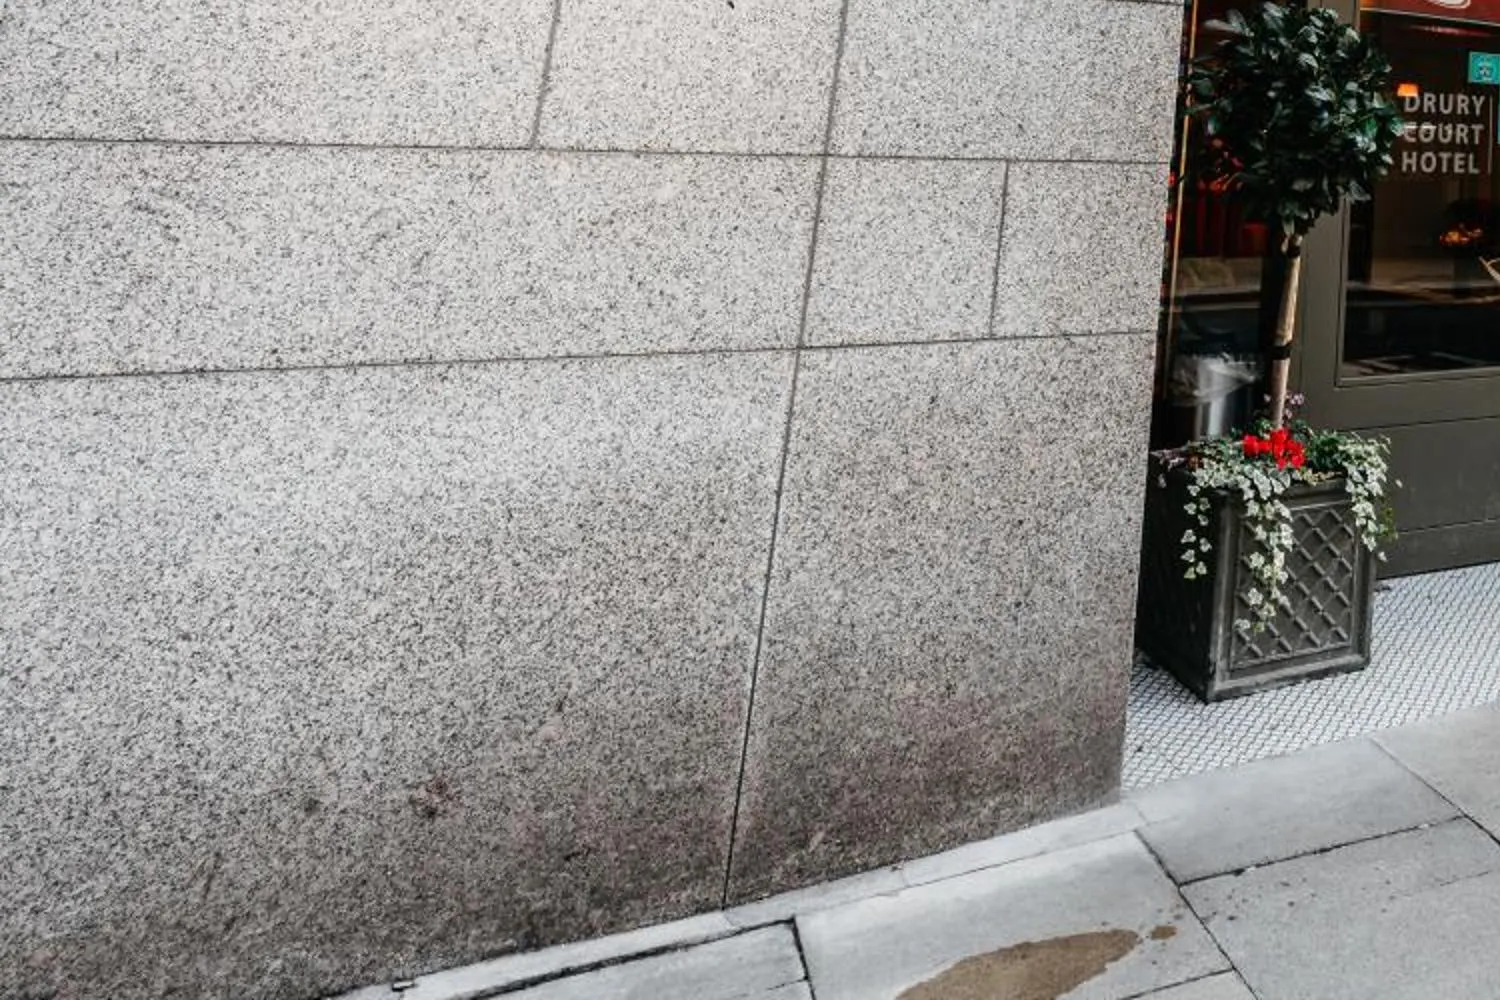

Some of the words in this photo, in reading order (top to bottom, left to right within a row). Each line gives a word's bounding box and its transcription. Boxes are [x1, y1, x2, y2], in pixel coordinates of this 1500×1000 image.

[1403, 91, 1486, 117] DRURY
[1402, 121, 1485, 146] COURT
[1401, 150, 1480, 175] HOTEL
